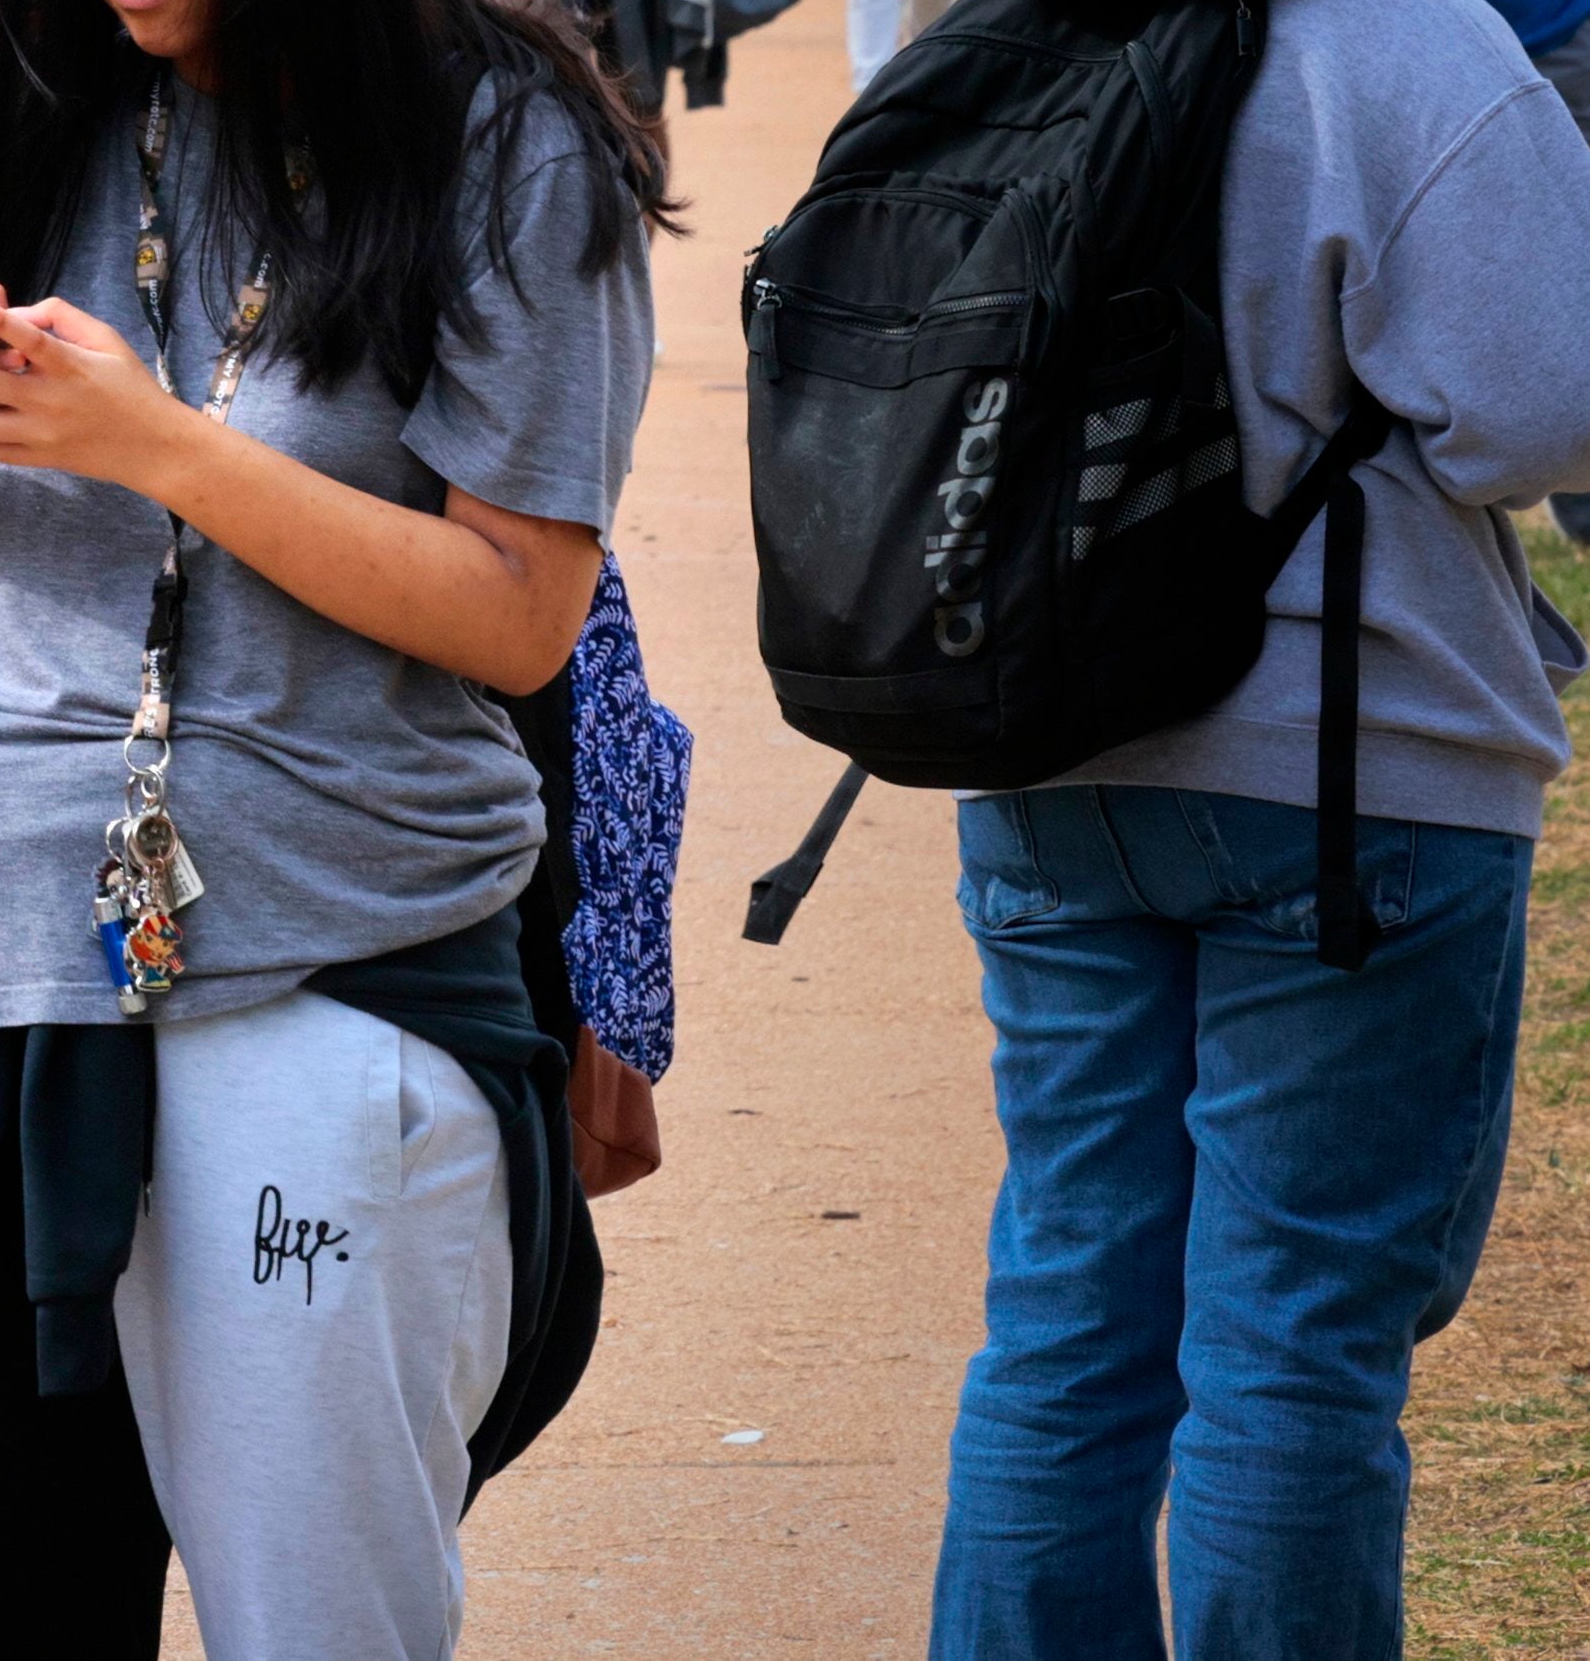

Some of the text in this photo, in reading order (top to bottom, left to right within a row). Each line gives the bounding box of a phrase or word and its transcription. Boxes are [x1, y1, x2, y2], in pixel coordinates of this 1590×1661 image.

[144, 72, 162, 153] myrotc.com
[210, 380, 229, 415] ROTC
[924, 376, 1009, 658] adidas
